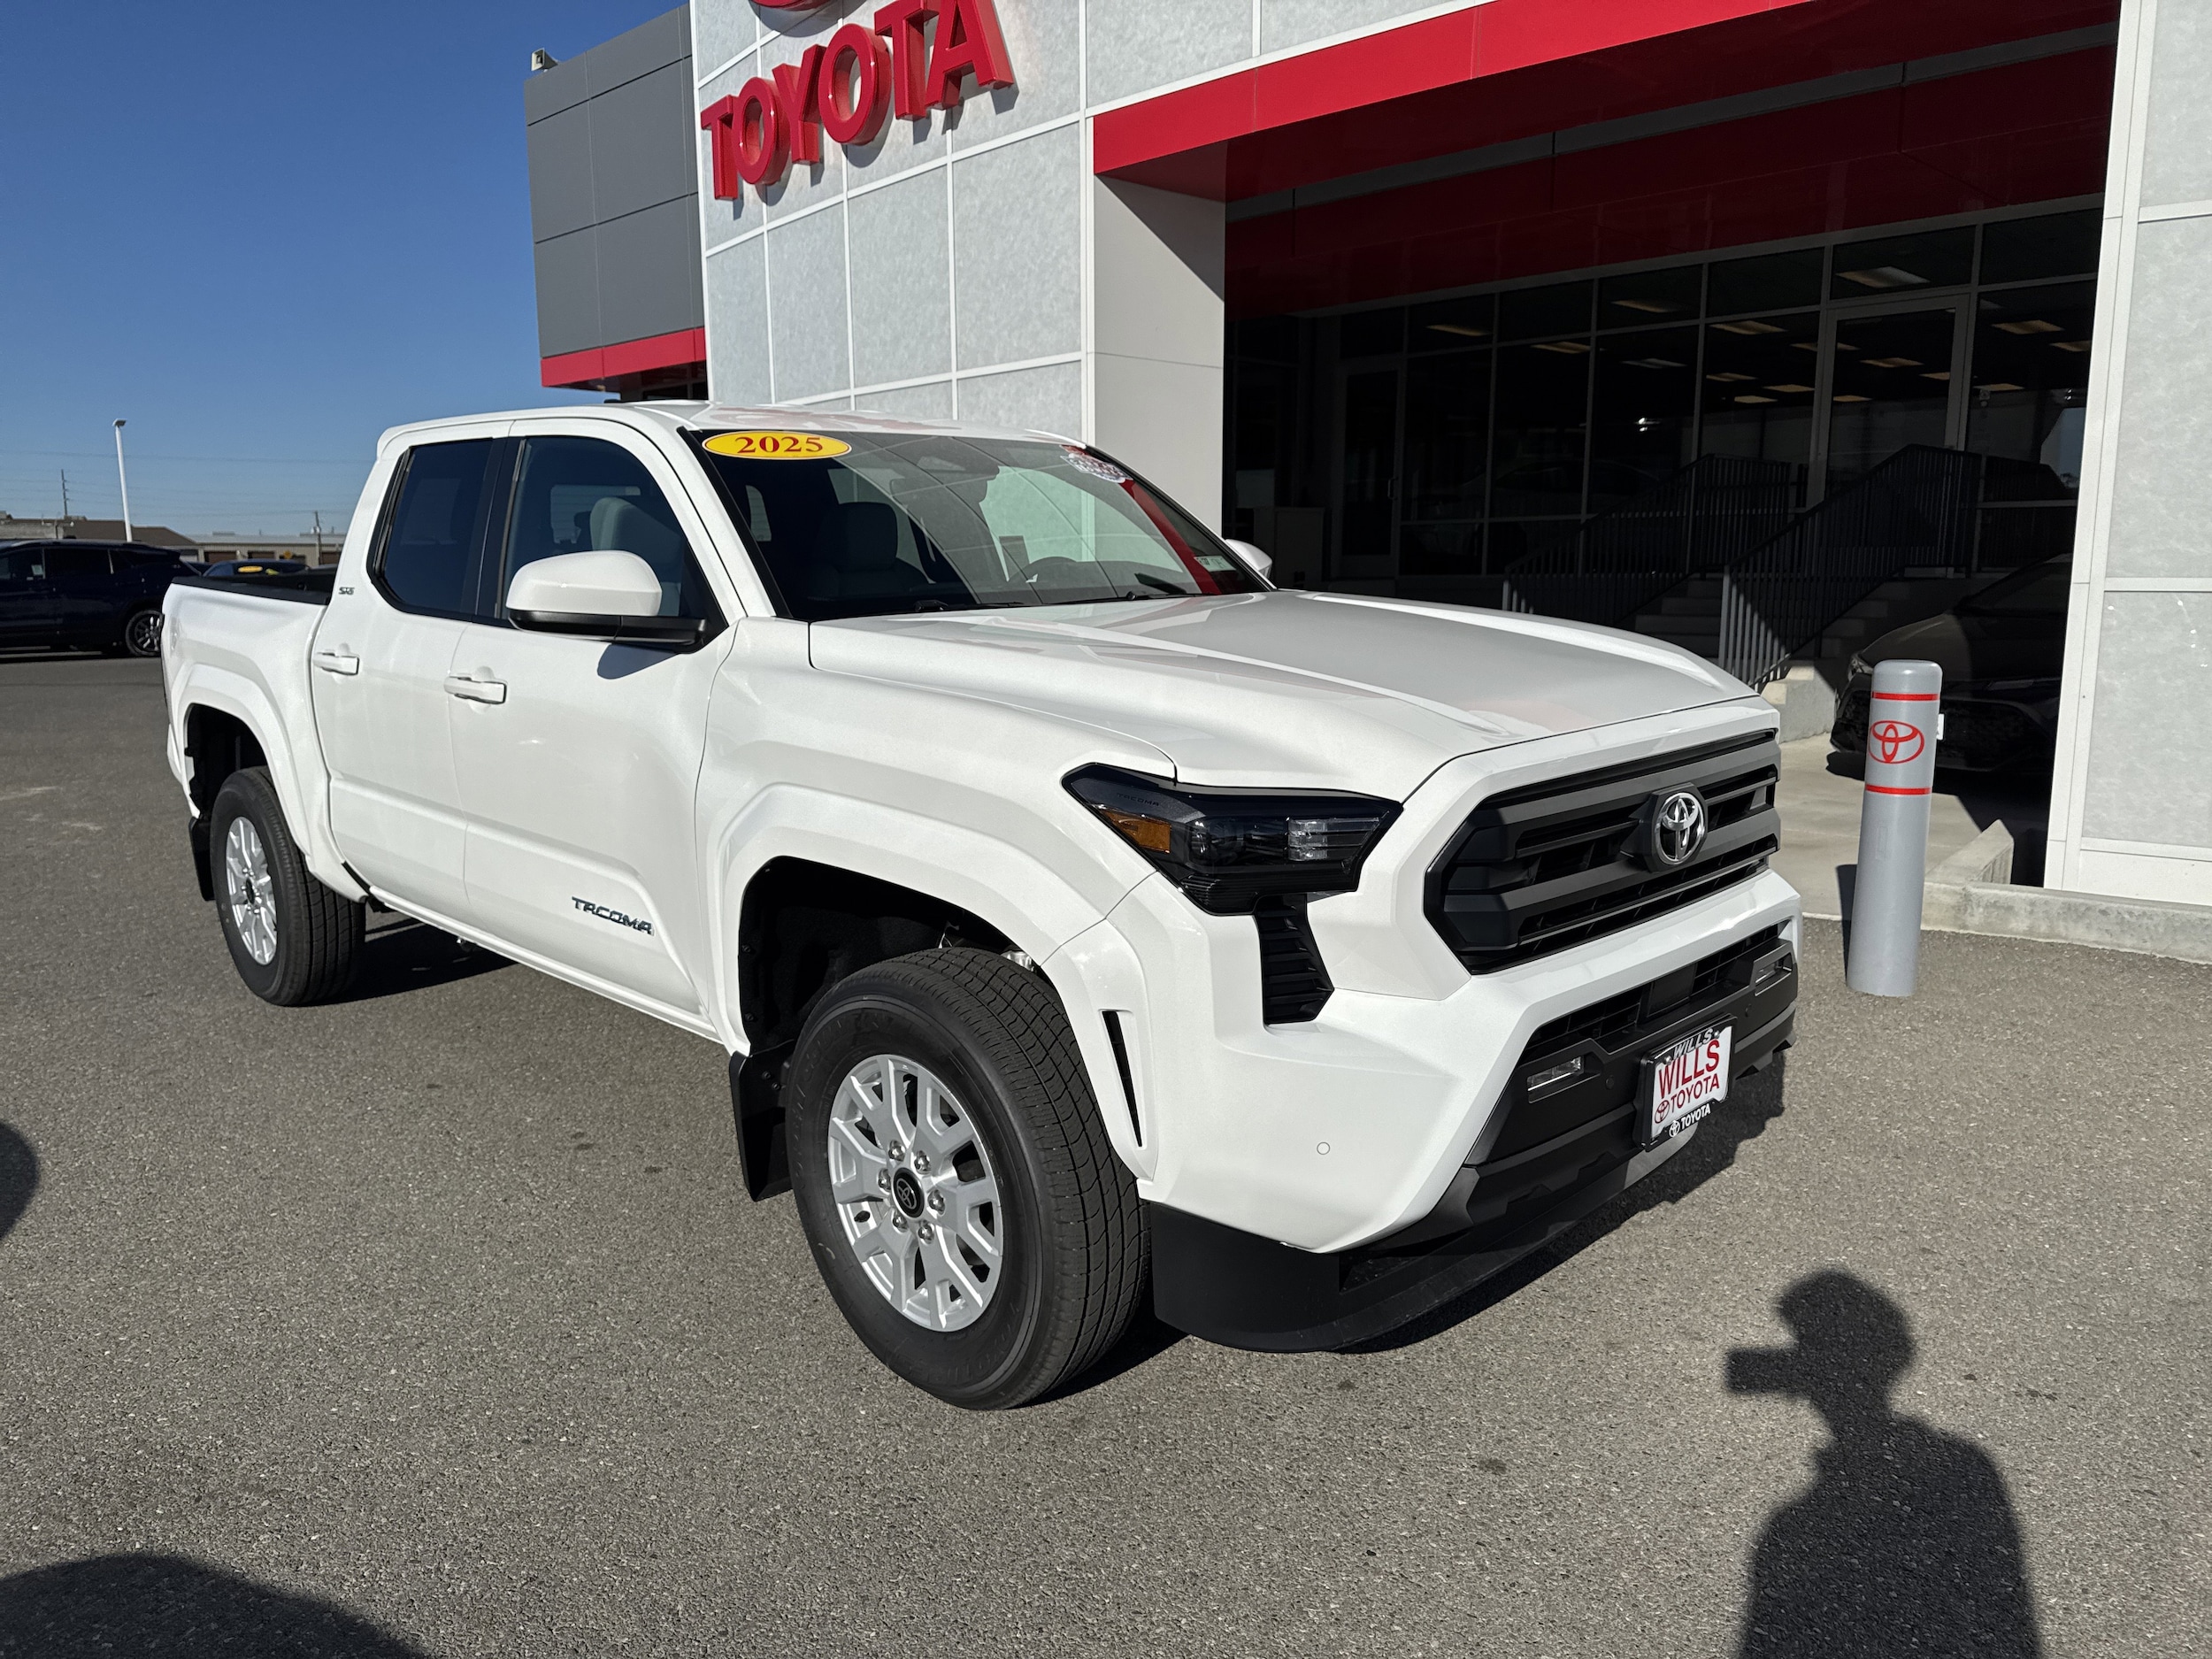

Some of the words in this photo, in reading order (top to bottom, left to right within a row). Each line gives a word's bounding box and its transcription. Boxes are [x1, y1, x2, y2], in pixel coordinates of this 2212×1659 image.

[701, 0, 1013, 201] TOYOTA
[733, 435, 825, 455] 2025
[572, 895, 655, 936] TACOMA
[1672, 1027, 1714, 1059] WILLS
[1658, 1039, 1720, 1100] WILLS
[1671, 1073, 1720, 1114] TOYOTA
[1681, 1103, 1711, 1128] TOYOTA
